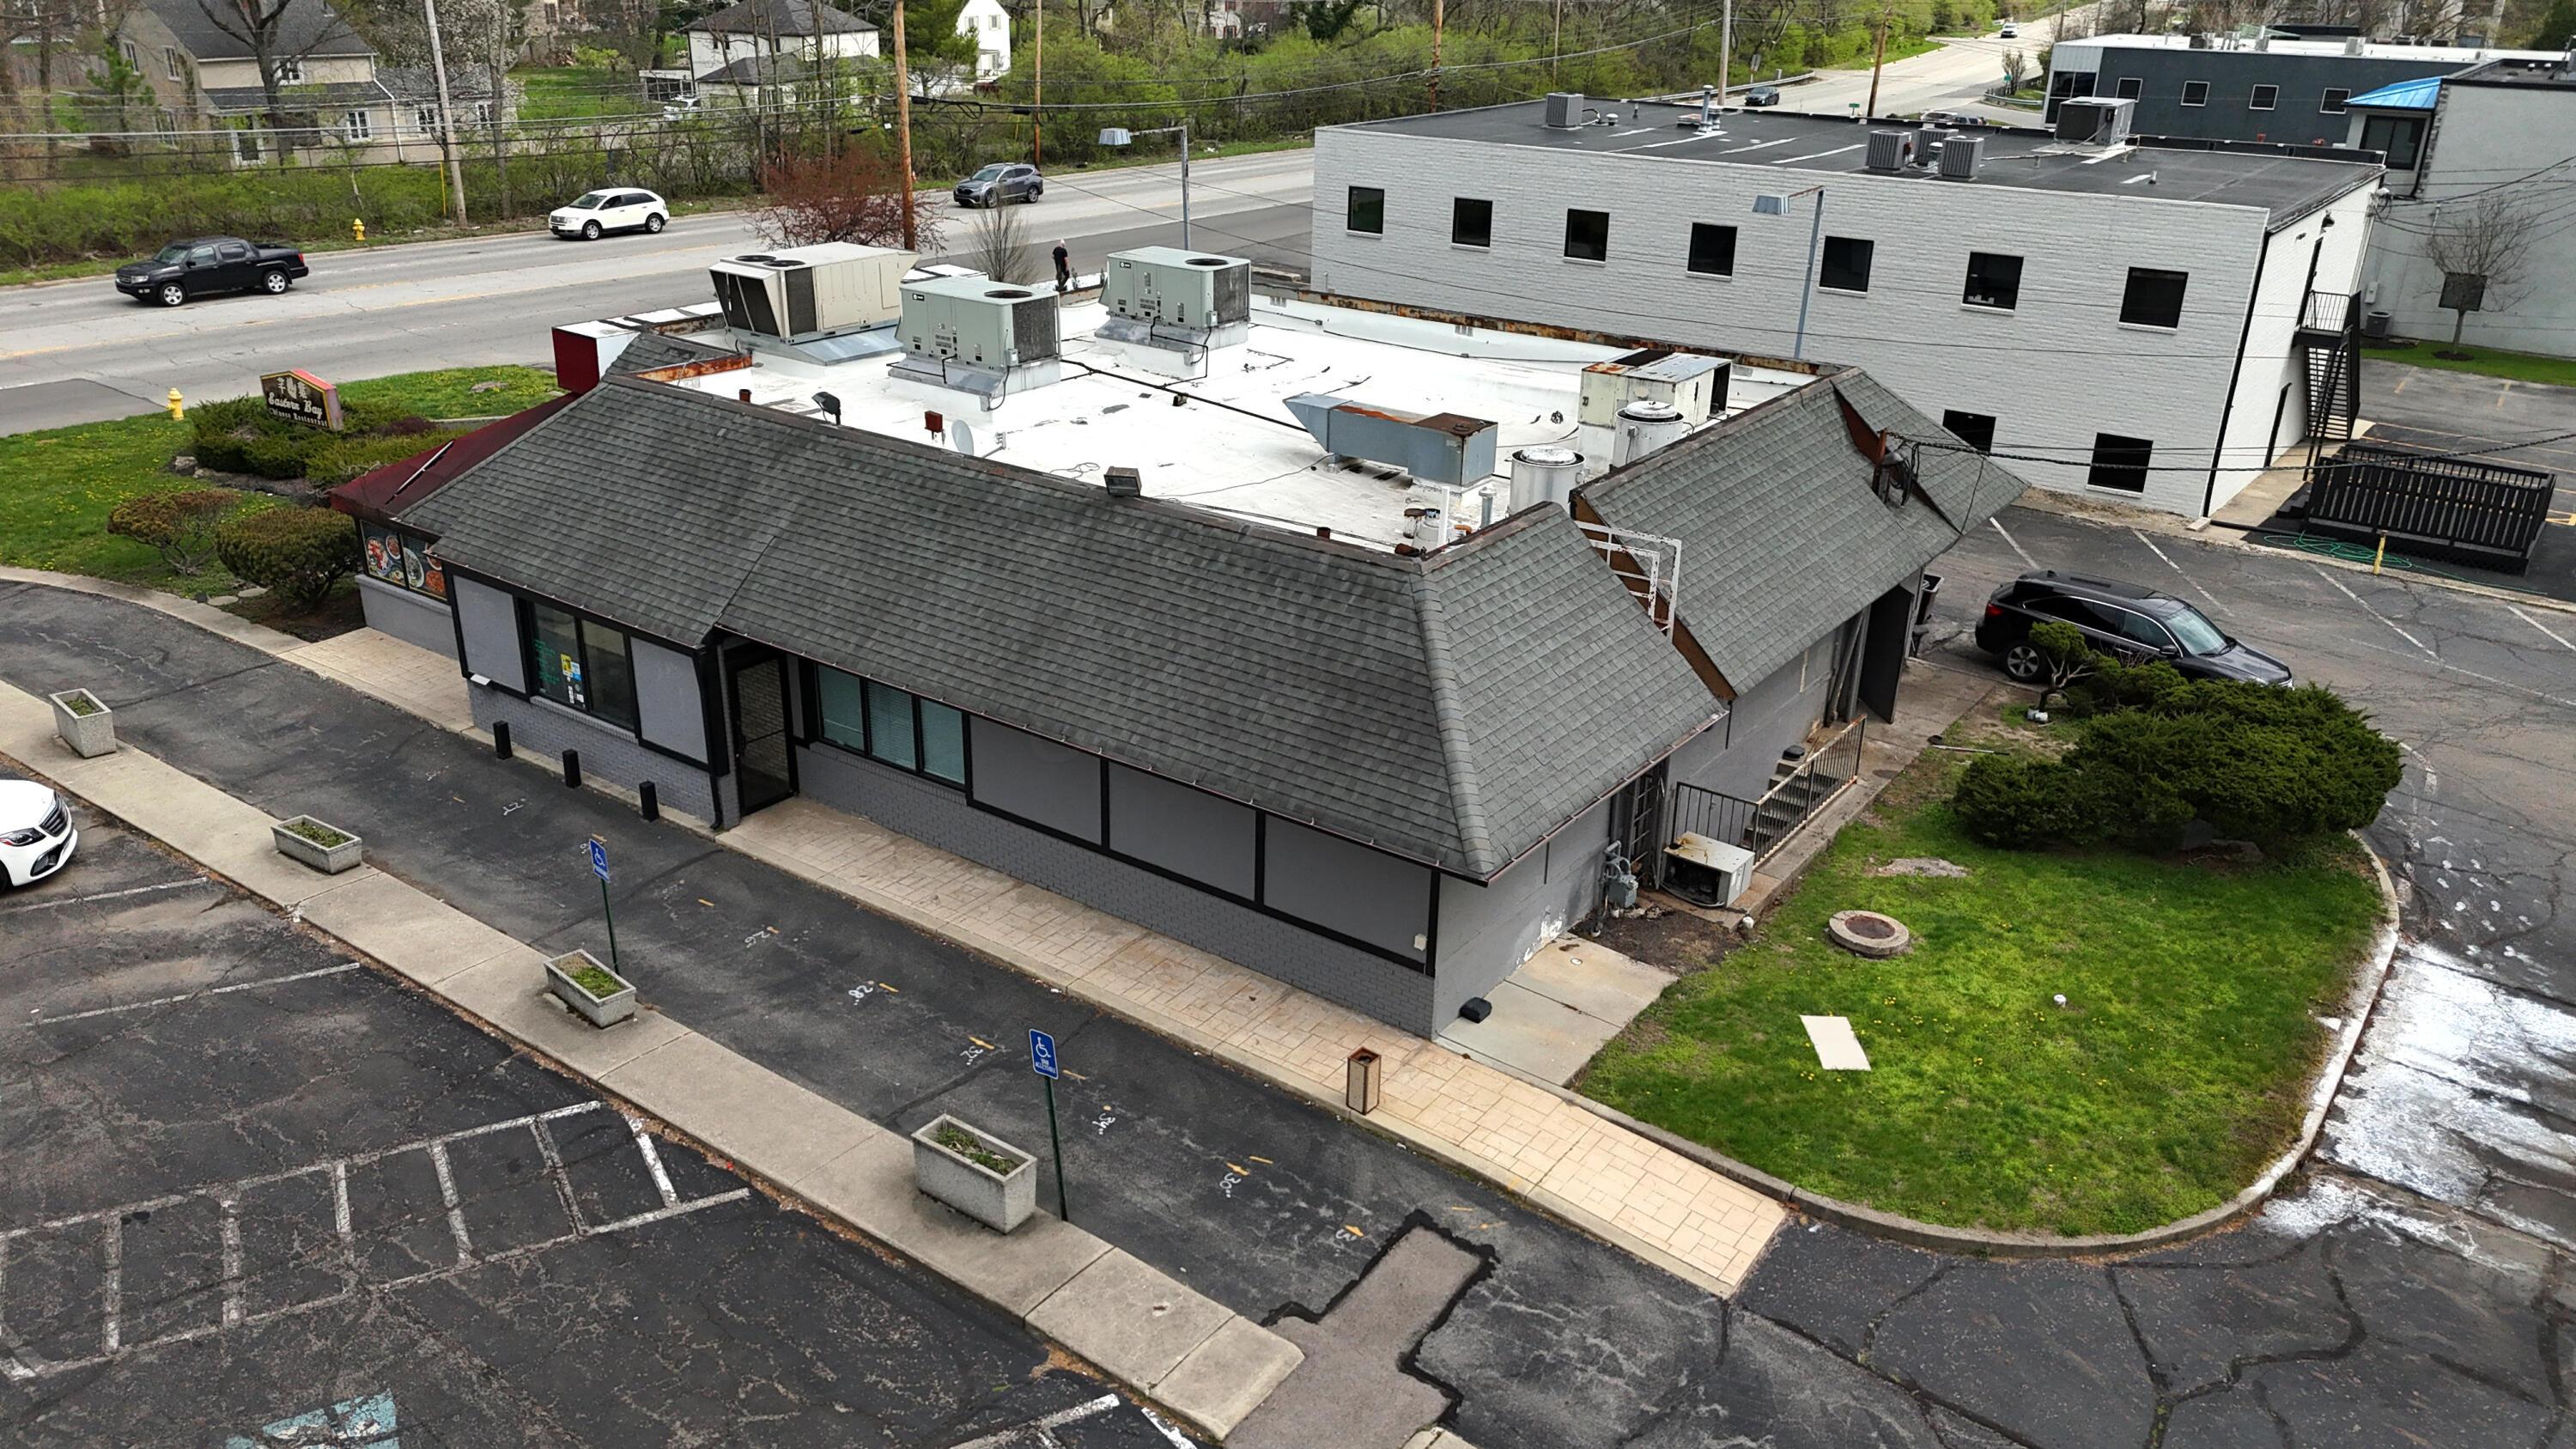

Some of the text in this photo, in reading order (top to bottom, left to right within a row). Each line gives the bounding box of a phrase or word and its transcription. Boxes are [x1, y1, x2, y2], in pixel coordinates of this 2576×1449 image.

[269, 392, 323, 419] Eastern Bay
[293, 412, 327, 427] Restaurant
